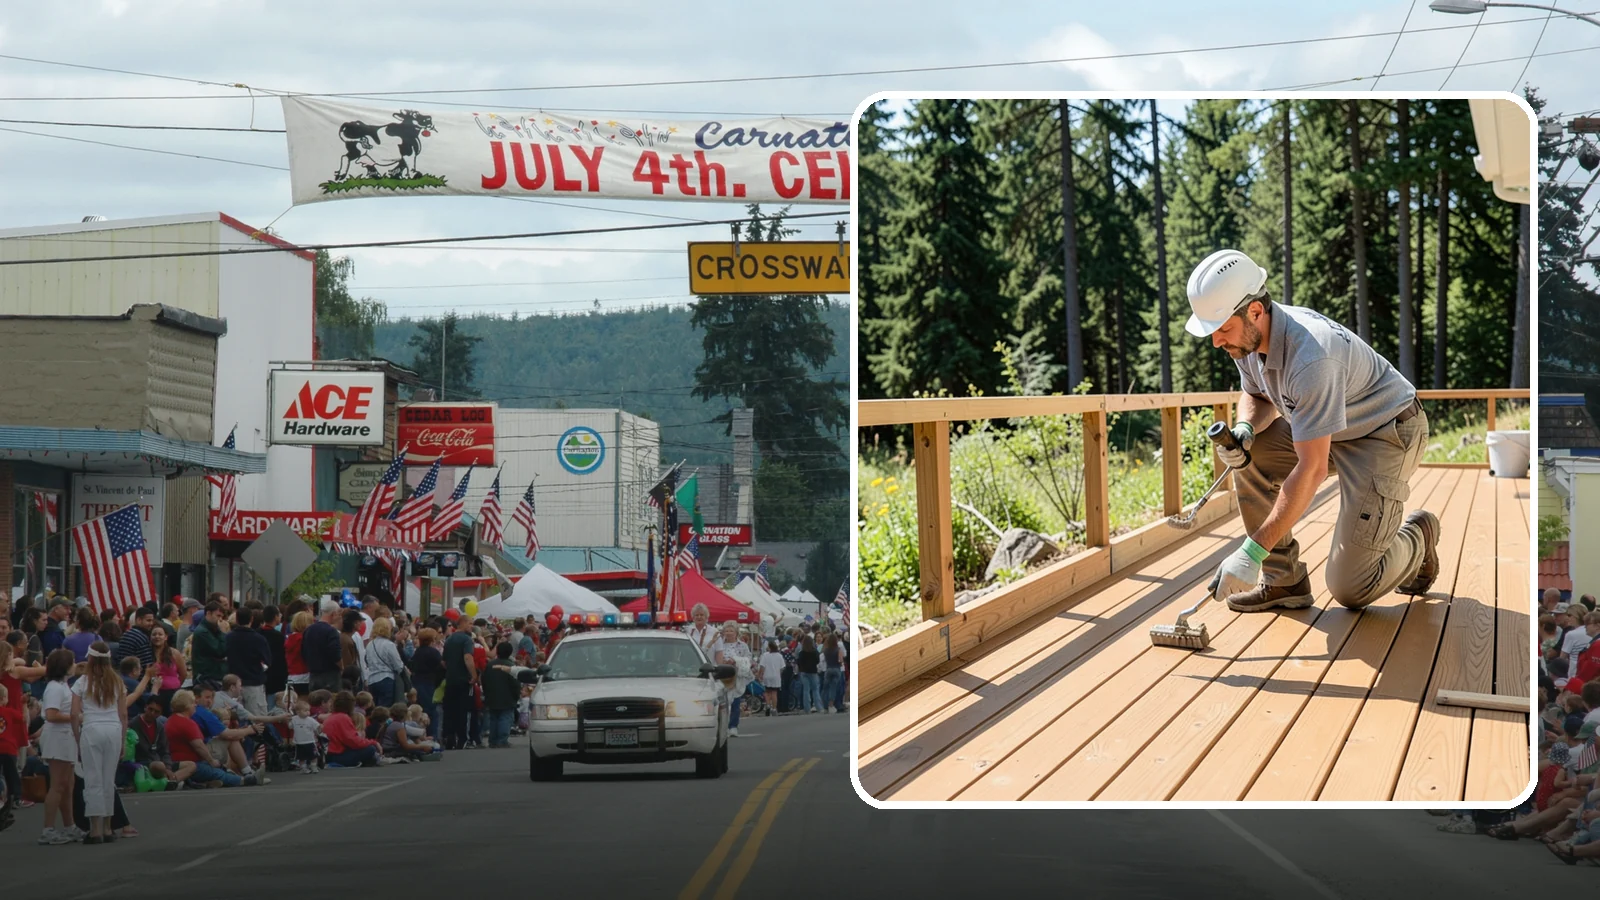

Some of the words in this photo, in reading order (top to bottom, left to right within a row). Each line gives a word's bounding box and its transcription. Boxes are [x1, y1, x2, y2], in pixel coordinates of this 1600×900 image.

[481, 141, 605, 193] JULY
[632, 150, 747, 198] 4th.
[696, 254, 850, 280] CROSSWA
[282, 379, 374, 420] ACE
[405, 409, 453, 421] CEDAR
[283, 421, 371, 436] Hardware
[416, 428, 477, 447] Coca-Cola
[353, 467, 384, 480] Simpl
[82, 484, 95, 494] St.
[95, 485, 124, 495] Vincent
[126, 485, 136, 495] de
[137, 486, 156, 495] Paul
[688, 526, 741, 535] CRNATION
[699, 535, 730, 543] GLASS
